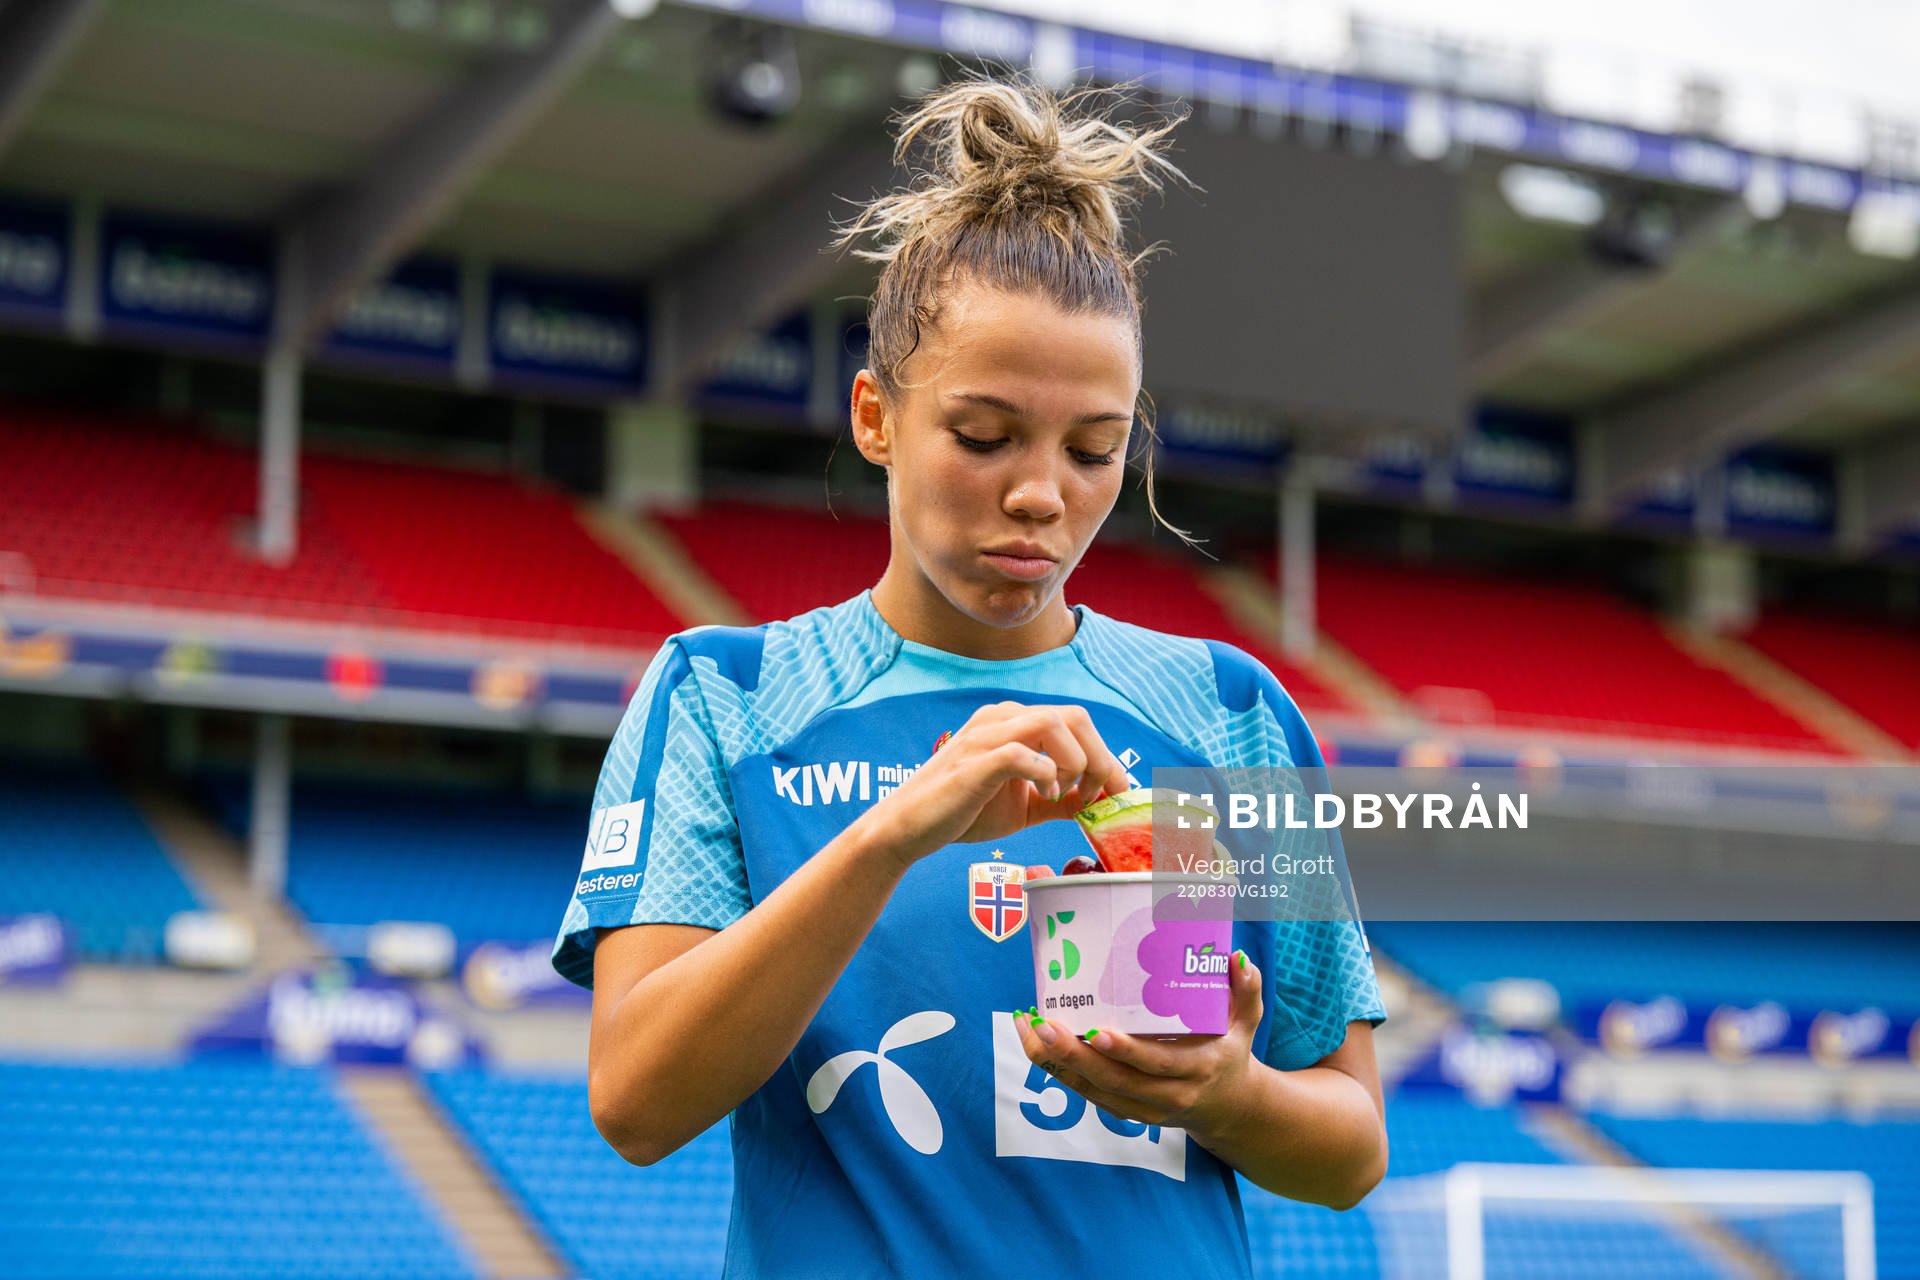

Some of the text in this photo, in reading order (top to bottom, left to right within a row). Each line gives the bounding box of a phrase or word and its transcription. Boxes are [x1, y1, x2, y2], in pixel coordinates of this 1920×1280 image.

[772, 761, 870, 806] KIWI
[578, 872, 642, 895] esterer
[1045, 994, 1094, 1010] om dagen
